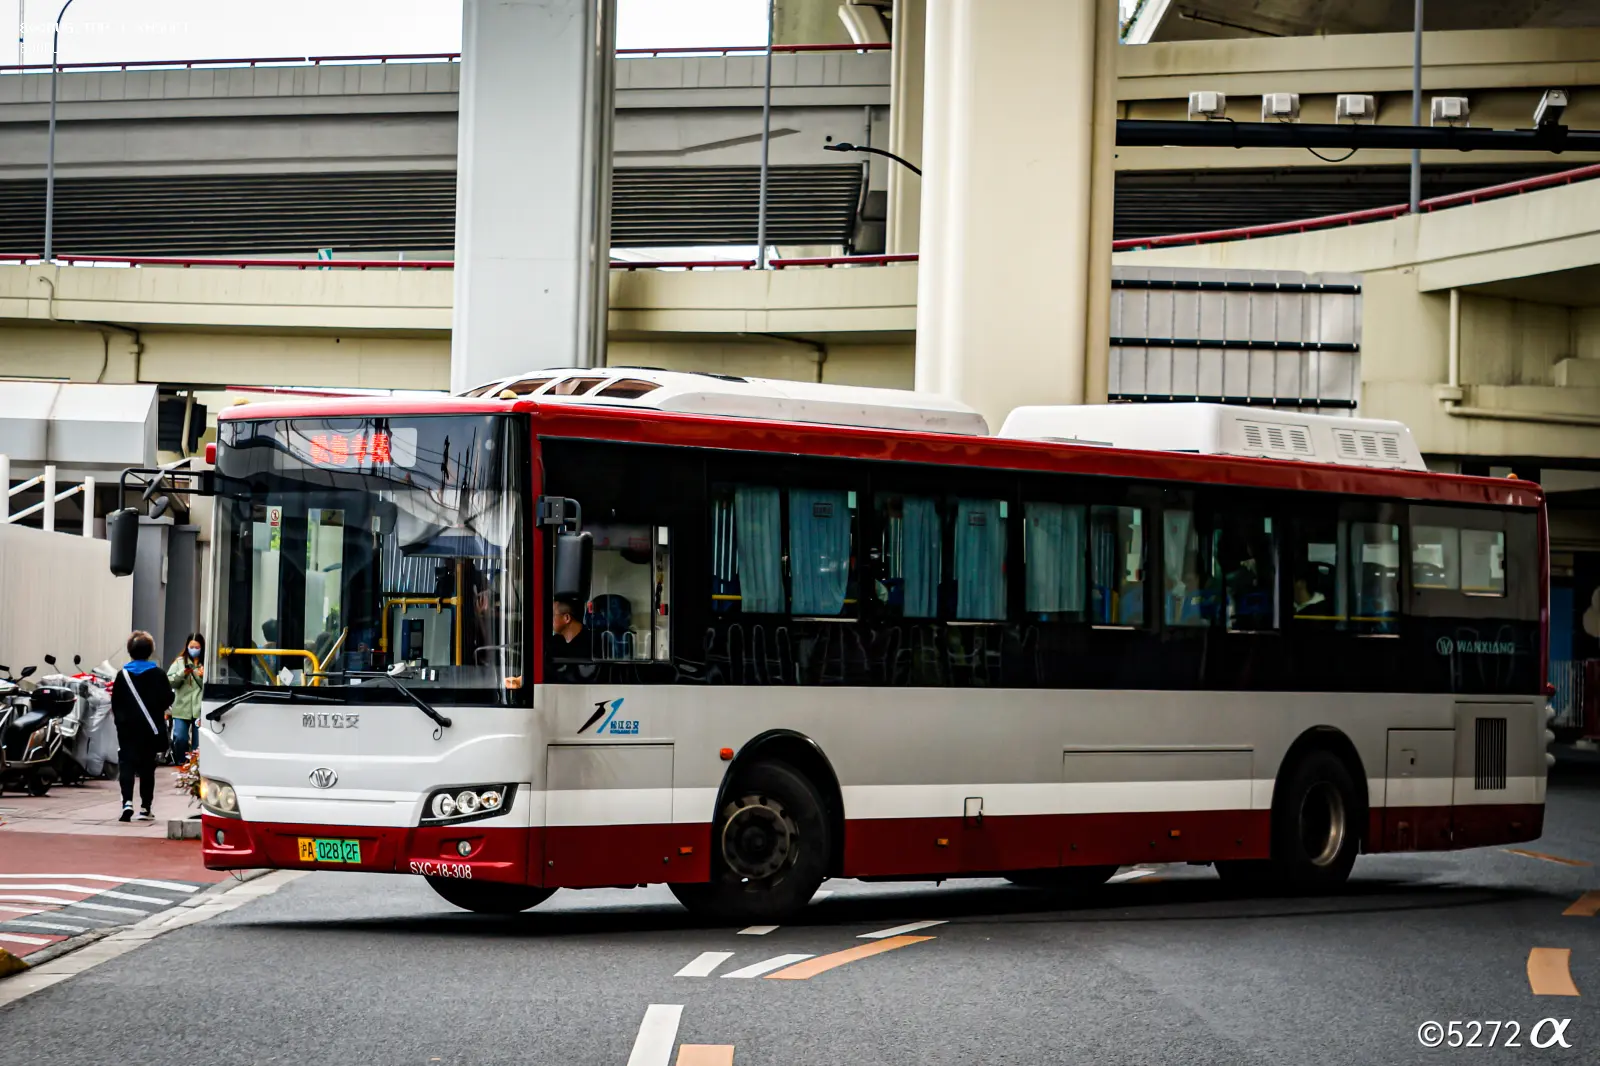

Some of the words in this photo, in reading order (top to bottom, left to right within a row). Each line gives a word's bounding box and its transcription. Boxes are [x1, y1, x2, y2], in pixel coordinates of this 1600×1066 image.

[1457, 640, 1515, 654] WANXIANG
[302, 712, 360, 729] 松江公交
[409, 861, 473, 880] SXC-18-308
